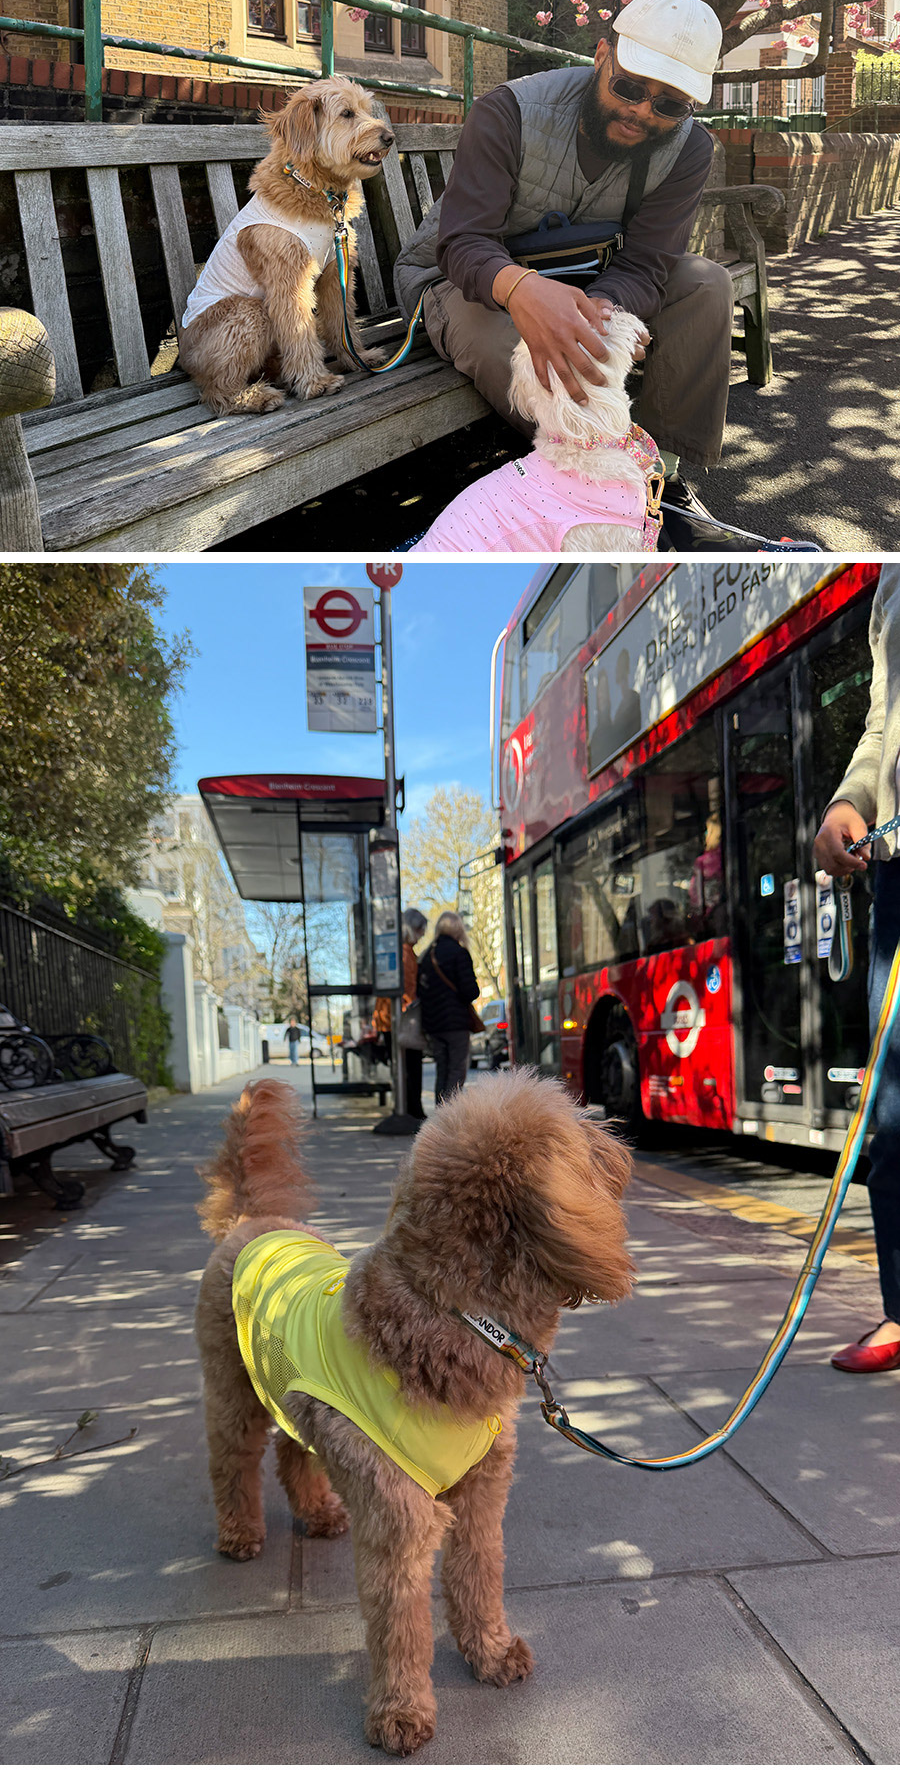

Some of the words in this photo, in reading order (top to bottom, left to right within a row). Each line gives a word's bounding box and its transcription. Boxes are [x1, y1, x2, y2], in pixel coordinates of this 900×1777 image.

[372, 562, 397, 577] PR
[713, 562, 751, 602] FO
[304, 783, 336, 791] Crescent
[466, 1311, 505, 1343] ANDOR
